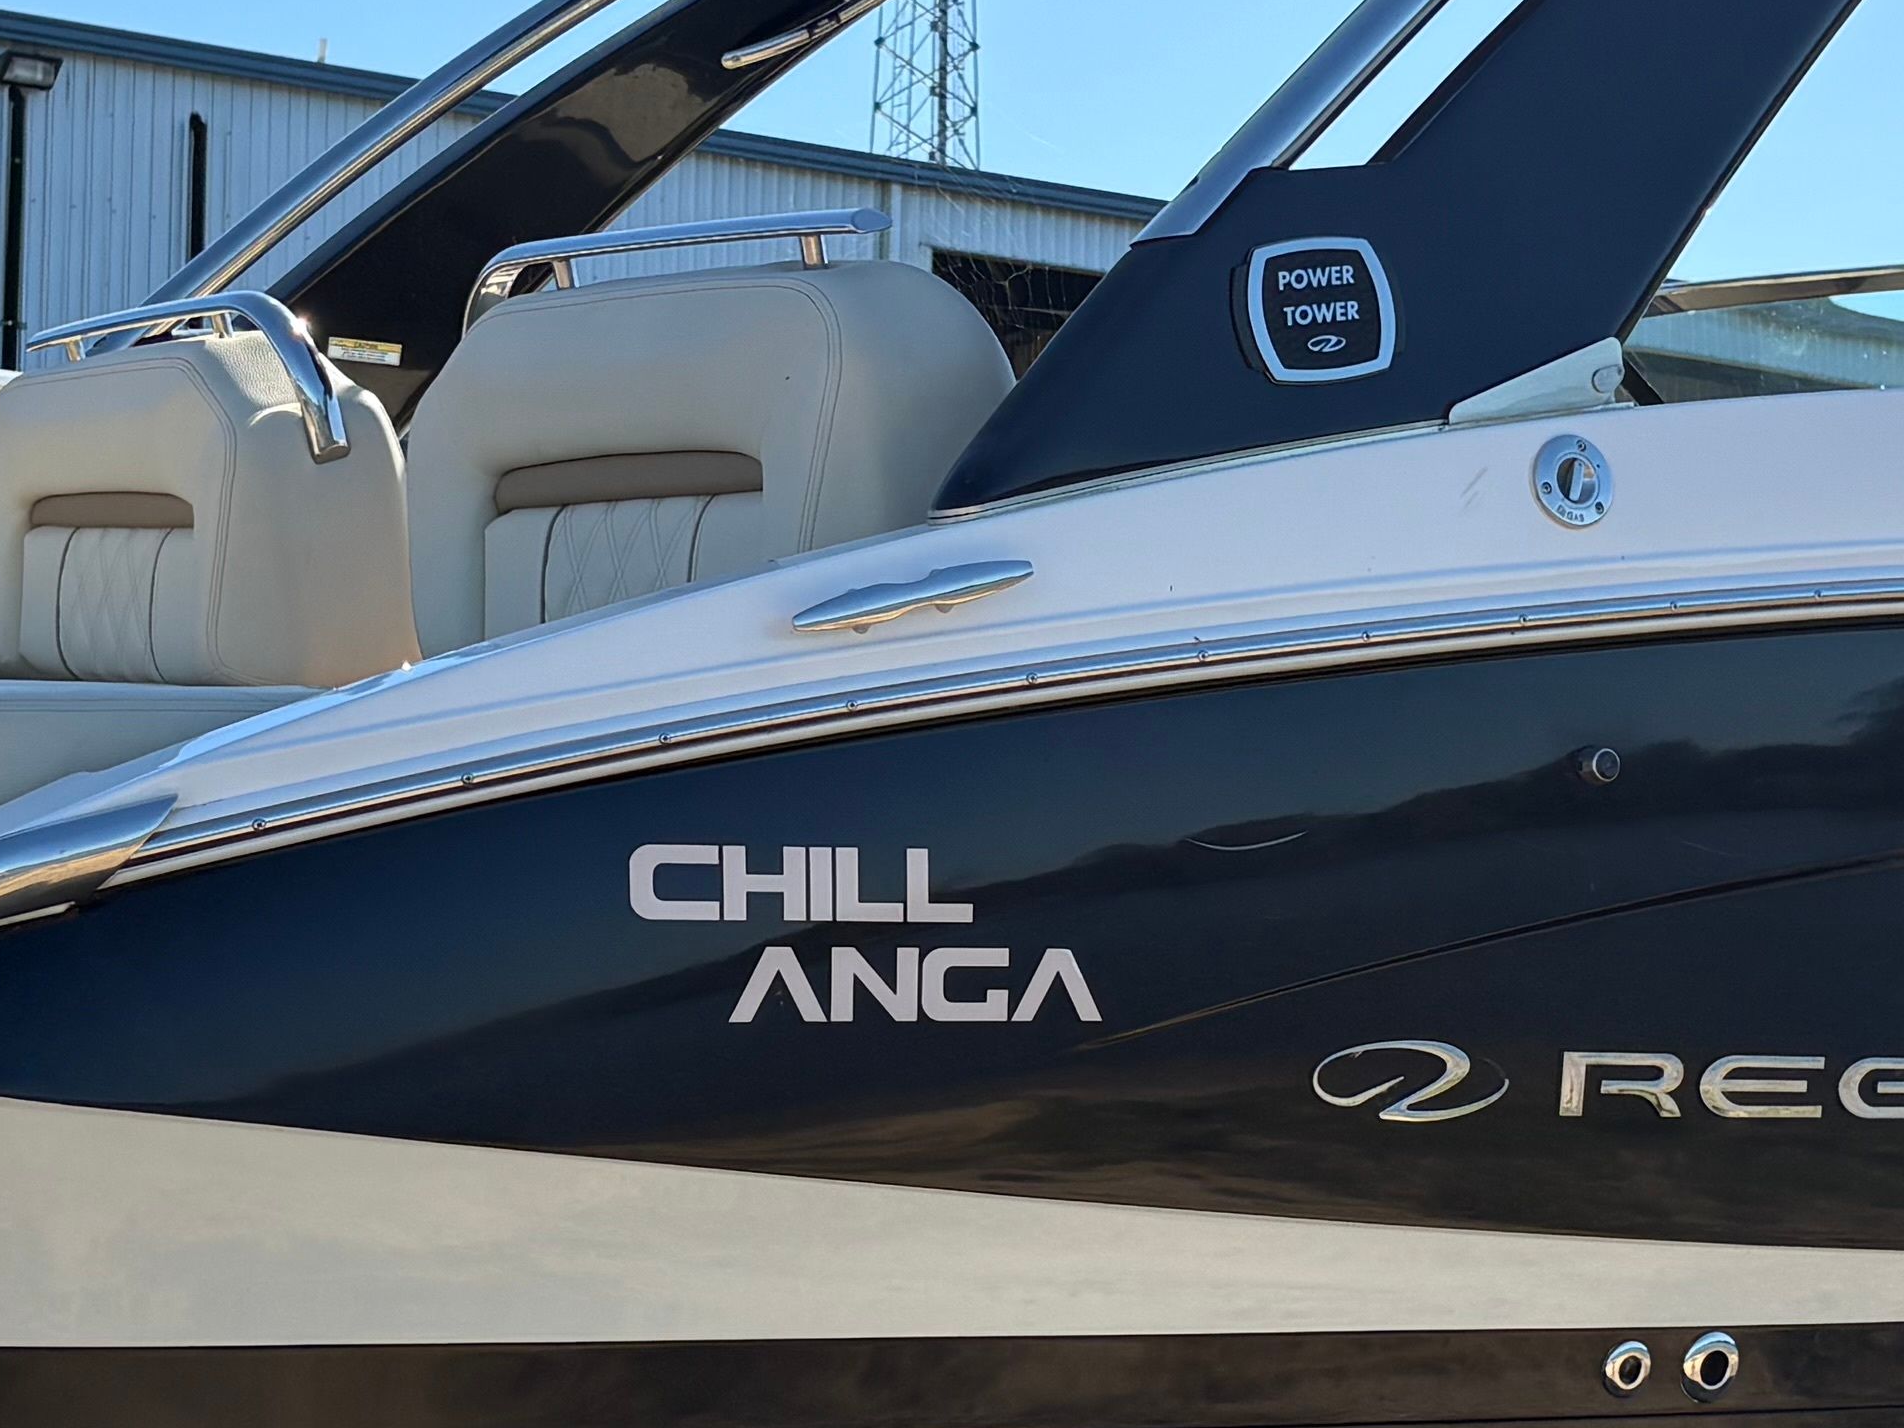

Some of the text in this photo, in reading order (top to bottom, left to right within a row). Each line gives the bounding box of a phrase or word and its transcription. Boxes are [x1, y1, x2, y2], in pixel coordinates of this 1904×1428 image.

[1278, 265, 1355, 291] POWER
[1283, 301, 1360, 326] TOWER
[629, 844, 973, 922] CHILL
[728, 946, 1103, 1022] ANGA
